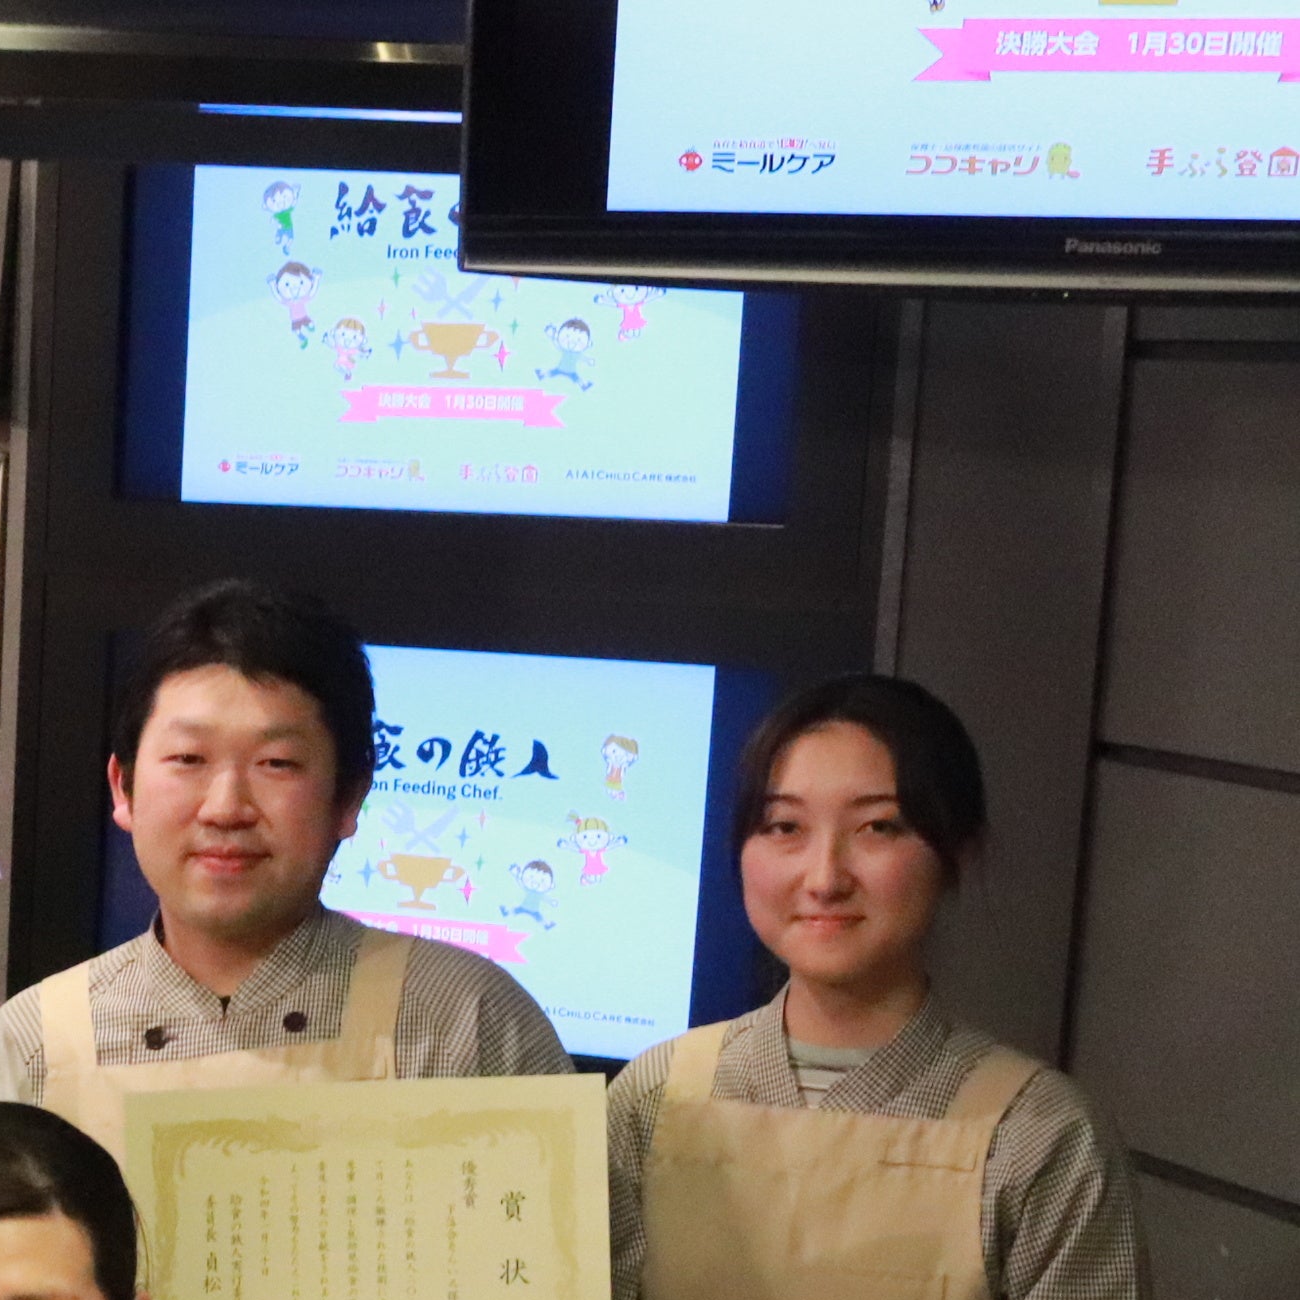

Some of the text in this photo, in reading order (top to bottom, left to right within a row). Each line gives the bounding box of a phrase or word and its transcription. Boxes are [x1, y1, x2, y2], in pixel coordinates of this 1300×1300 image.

[995, 30, 1284, 57] 決勝大会 1月30日開催
[711, 151, 836, 174] ミールケア
[905, 153, 1041, 175] ココキャリ
[386, 244, 419, 259] Iron
[1064, 237, 1162, 255] Panasonic
[394, 778, 456, 800] Feeding
